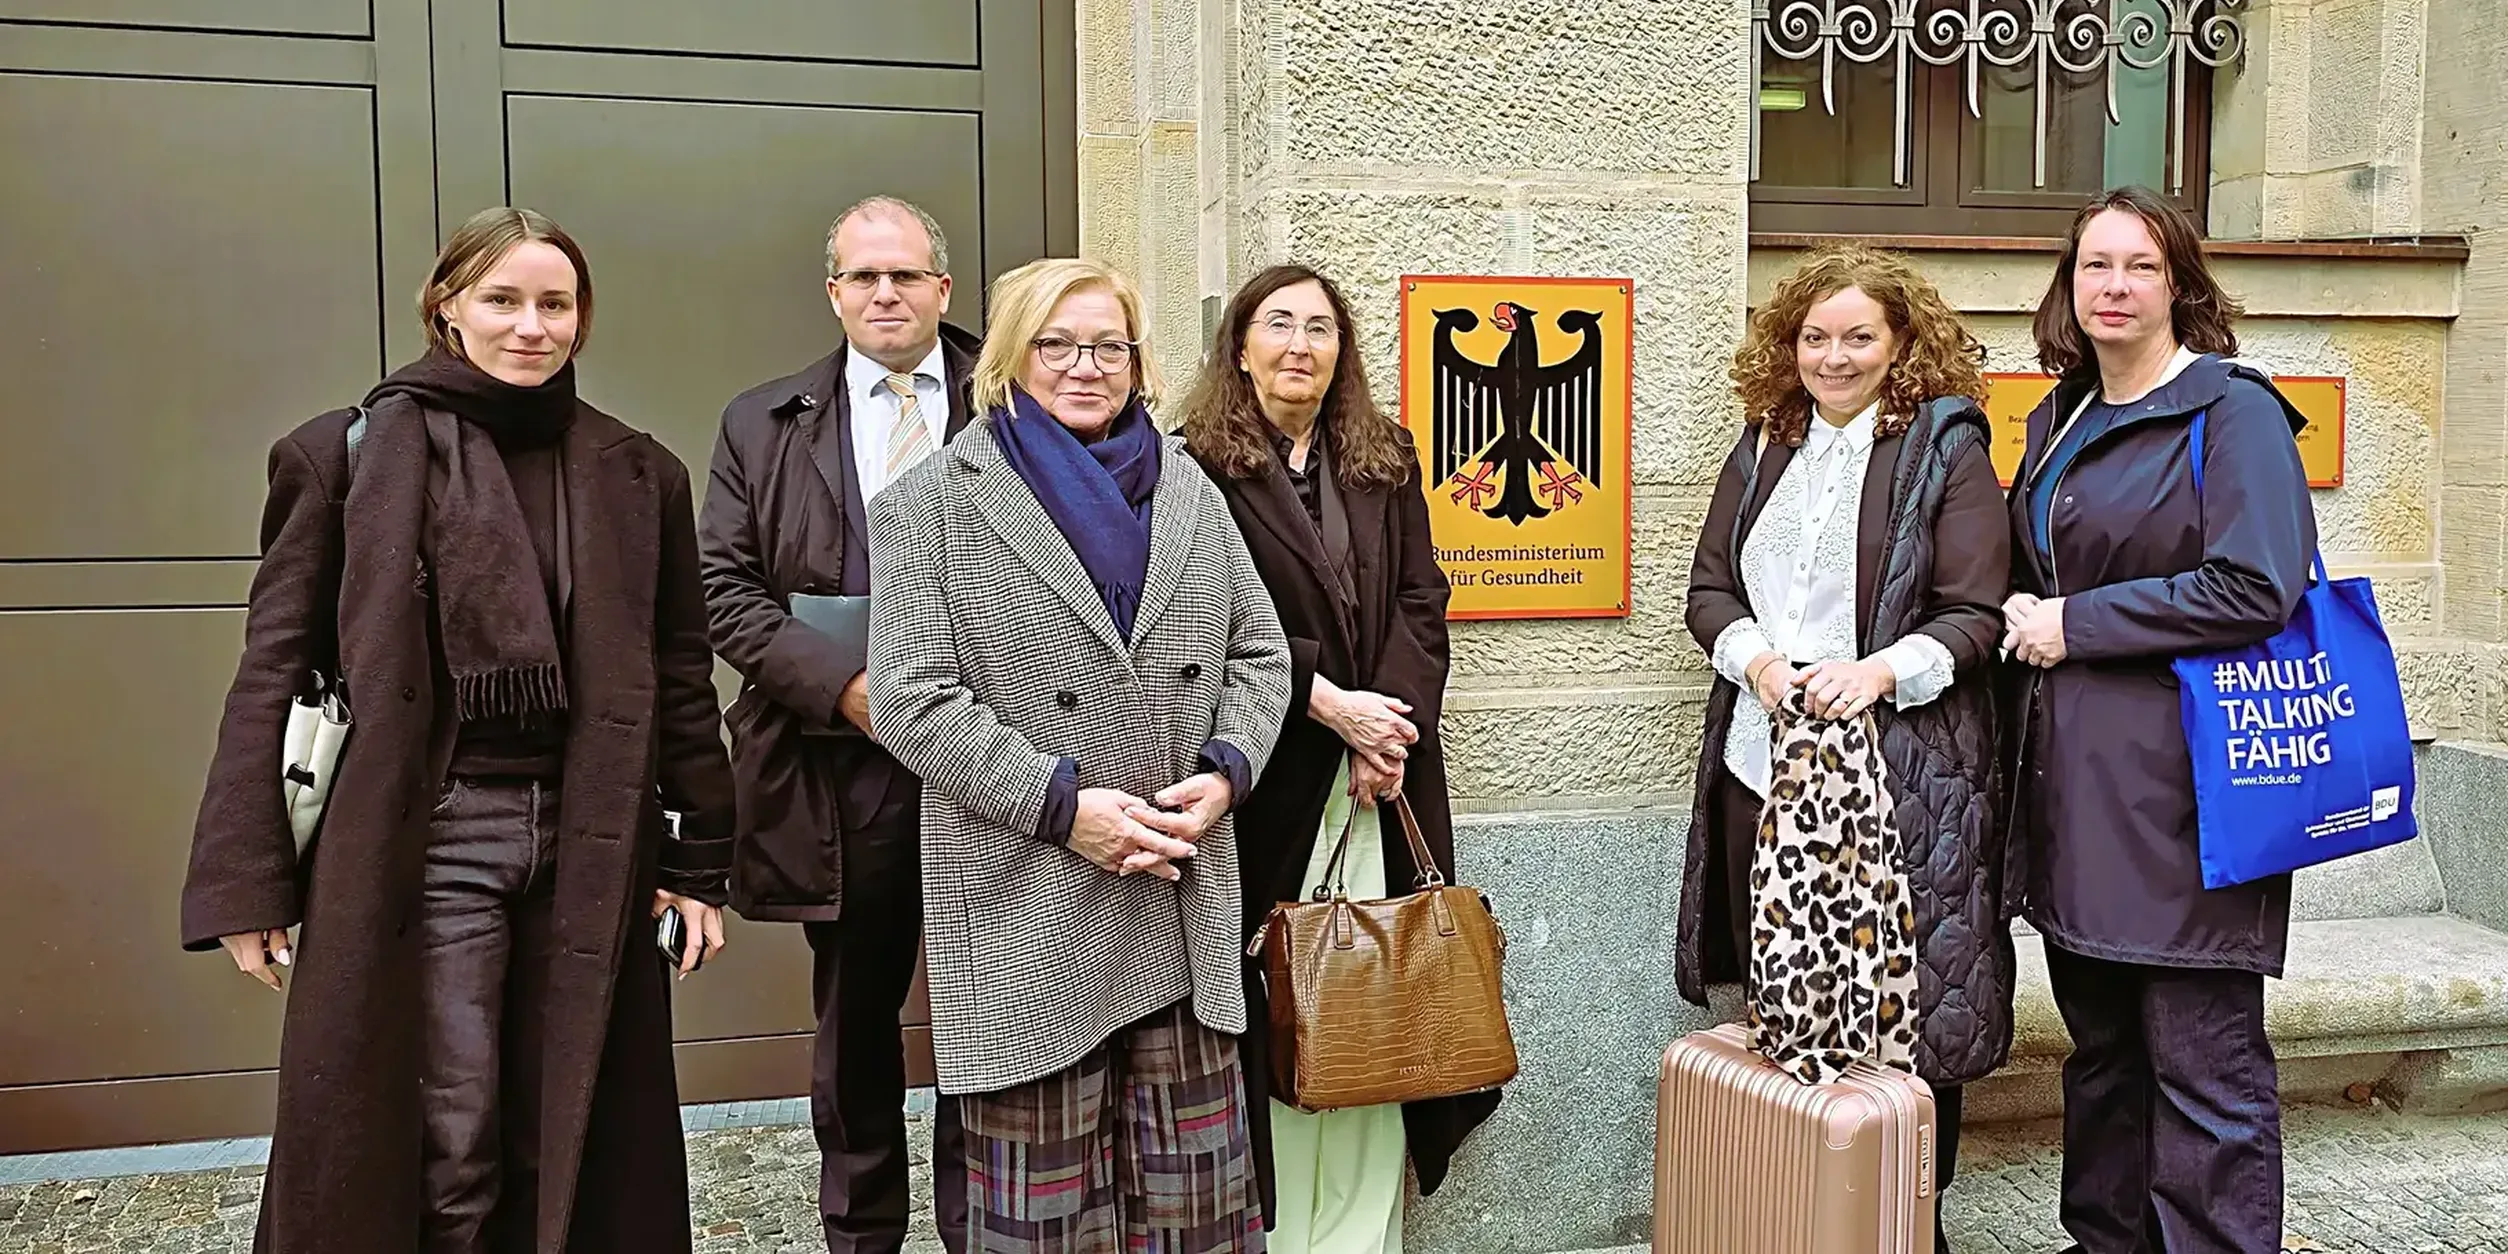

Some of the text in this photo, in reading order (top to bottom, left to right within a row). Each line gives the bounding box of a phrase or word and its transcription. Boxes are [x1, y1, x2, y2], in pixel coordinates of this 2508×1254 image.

[1432, 543, 1604, 562] Bundesministerium
[1450, 569, 1583, 586] für Gesundheit
[2218, 683, 2356, 731] TALKING
[2227, 730, 2331, 769] FÄHIG
[2231, 773, 2302, 786] www.bdue.de
